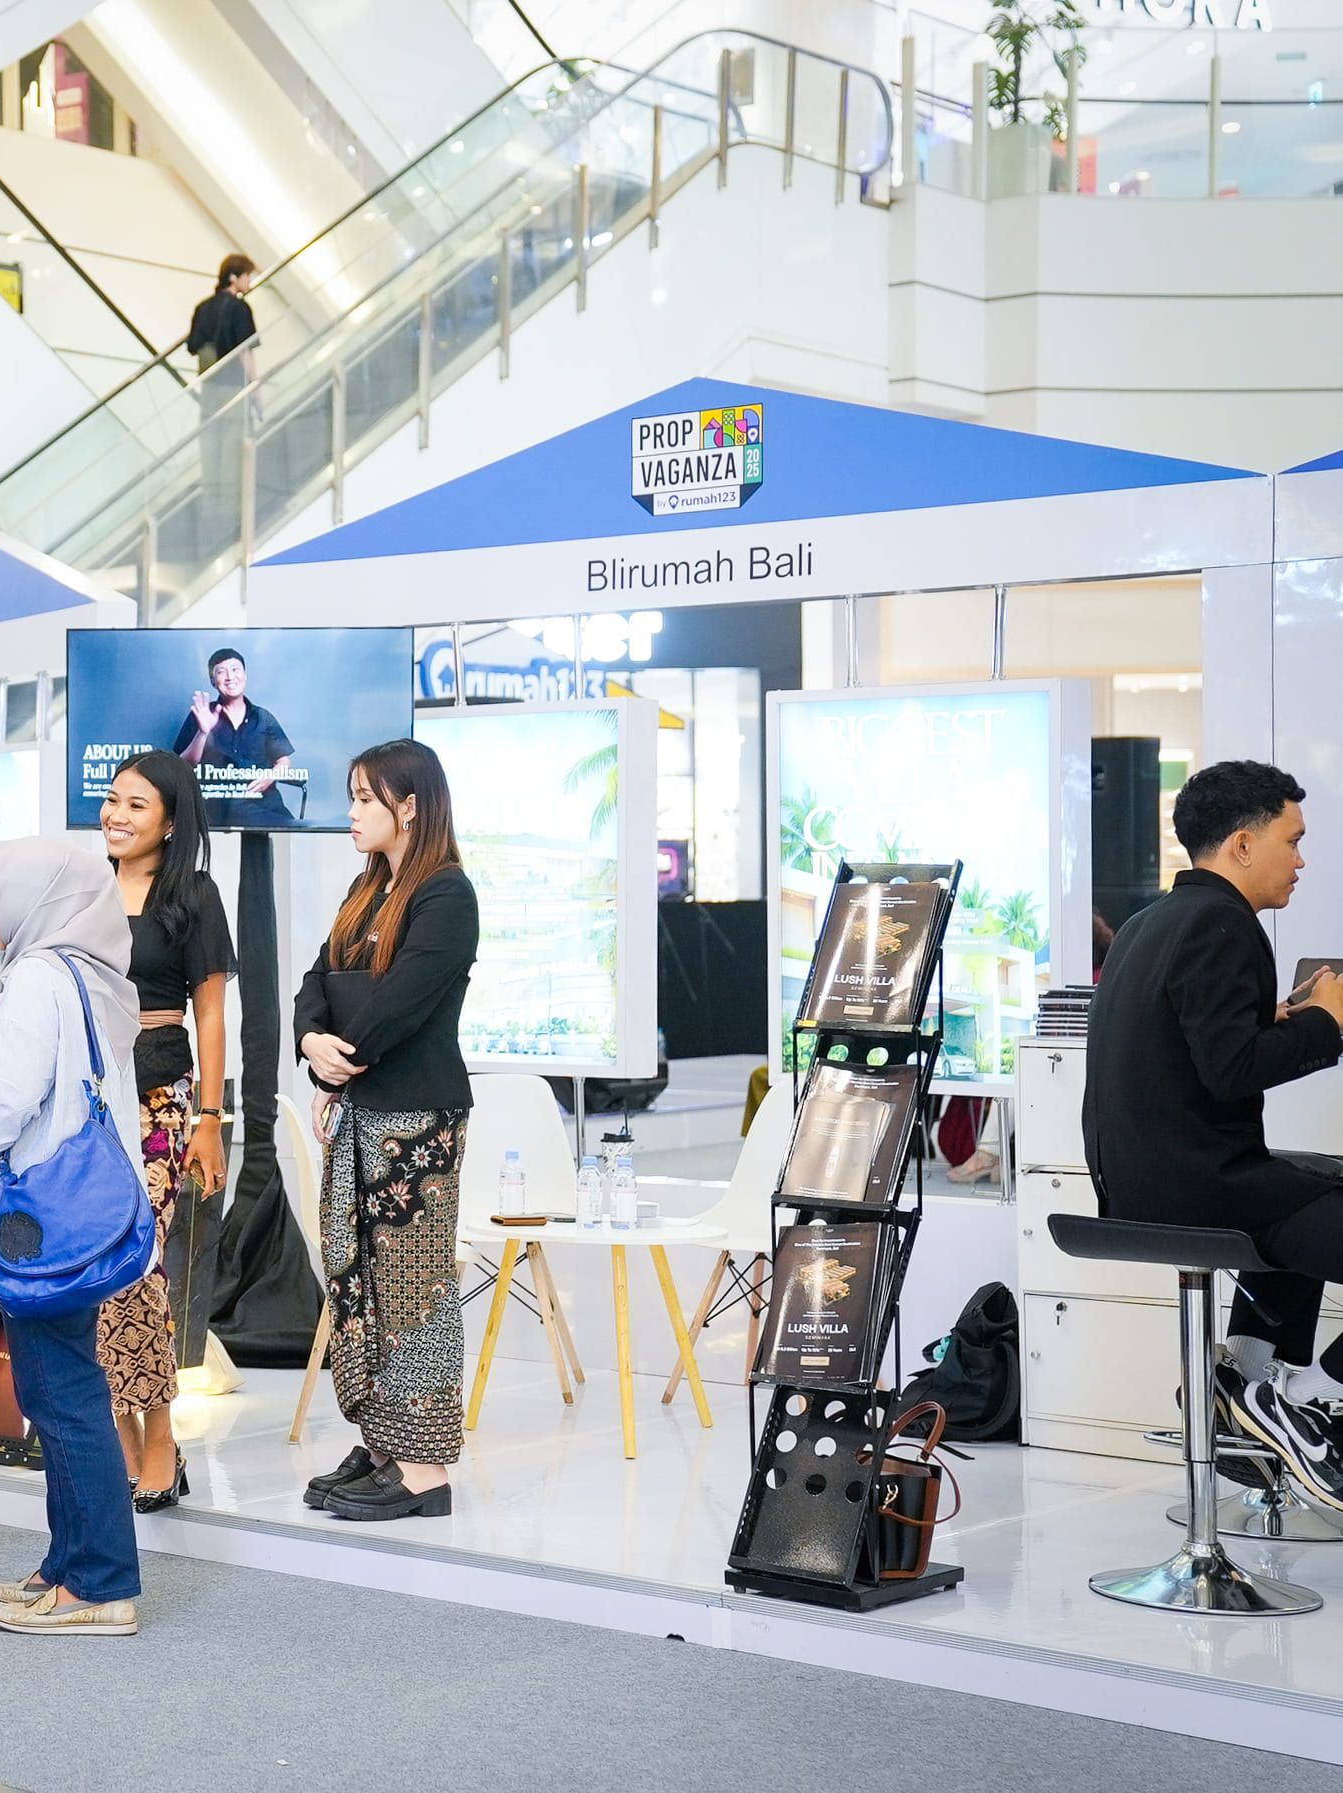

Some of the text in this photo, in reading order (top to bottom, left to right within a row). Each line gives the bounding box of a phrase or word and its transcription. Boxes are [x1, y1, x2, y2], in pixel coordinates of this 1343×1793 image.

[639, 419, 694, 451] PROP
[746, 448, 760, 463] 20
[640, 452, 737, 488] VAGANZA
[746, 463, 760, 478] 25
[681, 491, 737, 507] rumah123
[587, 542, 813, 592] Blirumah Bali
[83, 744, 131, 760] ABOUT
[83, 763, 108, 779] Full
[204, 763, 309, 781] Professionalism
[833, 974, 864, 985] LUSH
[787, 1323, 849, 1335] LUSH VILLA
